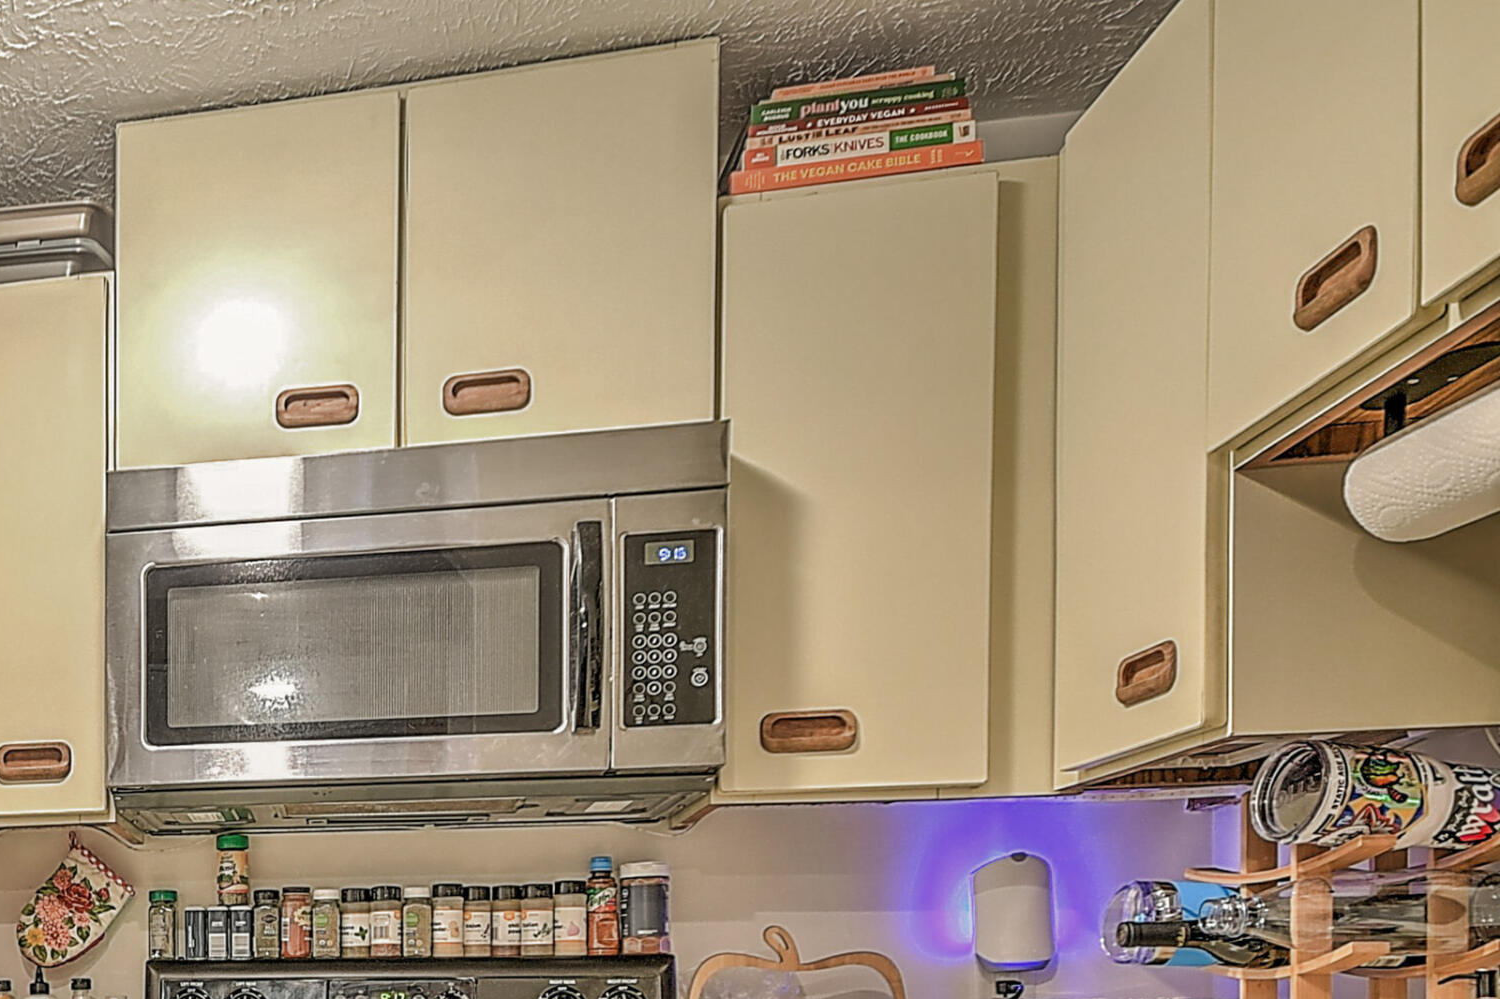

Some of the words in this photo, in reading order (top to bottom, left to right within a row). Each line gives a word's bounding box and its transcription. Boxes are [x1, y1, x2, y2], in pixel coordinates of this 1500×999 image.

[817, 113, 869, 128] EVERYDAY
[870, 108, 906, 120] VEGAN
[779, 132, 810, 144] LUST
[825, 125, 860, 137] LEAF
[895, 135, 908, 144] THE
[909, 130, 948, 142] COOKBOOK
[786, 143, 830, 160] FORKS
[834, 136, 885, 154] KNIVES
[773, 169, 798, 182] THE
[801, 163, 844, 179] VEGAN
[847, 158, 883, 173] CAKE
[886, 154, 922, 168] BIBLE
[1331, 779, 1345, 809] STATIC
